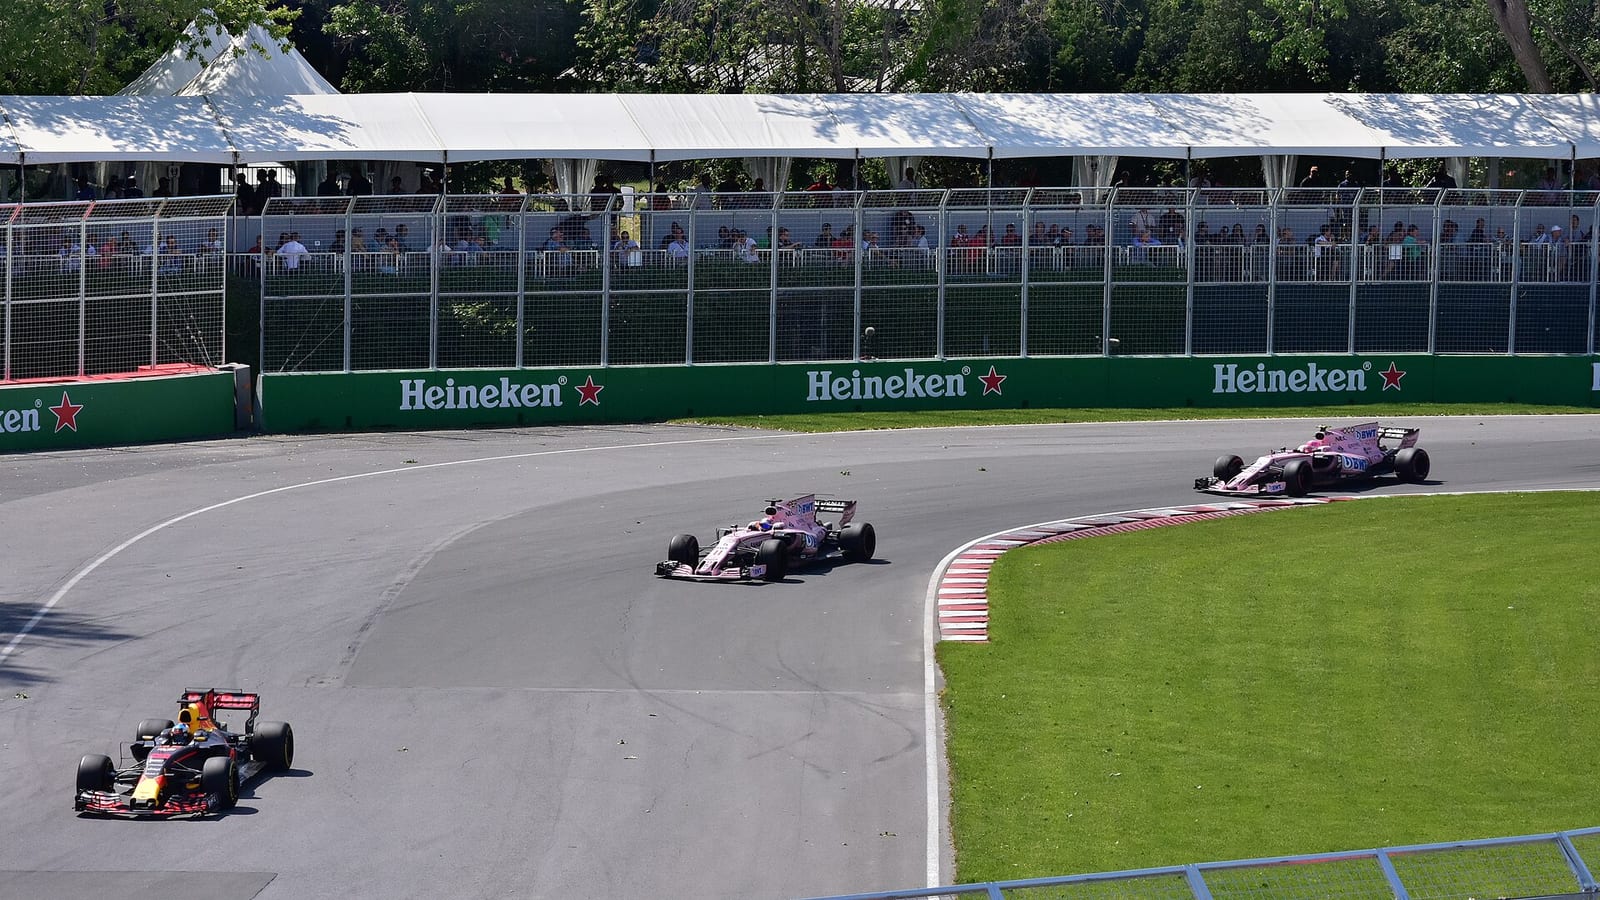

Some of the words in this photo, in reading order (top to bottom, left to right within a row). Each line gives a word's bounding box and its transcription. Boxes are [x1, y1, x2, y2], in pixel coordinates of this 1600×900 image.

[399, 377, 563, 410] Heineken
[806, 368, 967, 401] Heineken
[1213, 362, 1367, 393] Heineken
[1361, 428, 1377, 439] BWT
